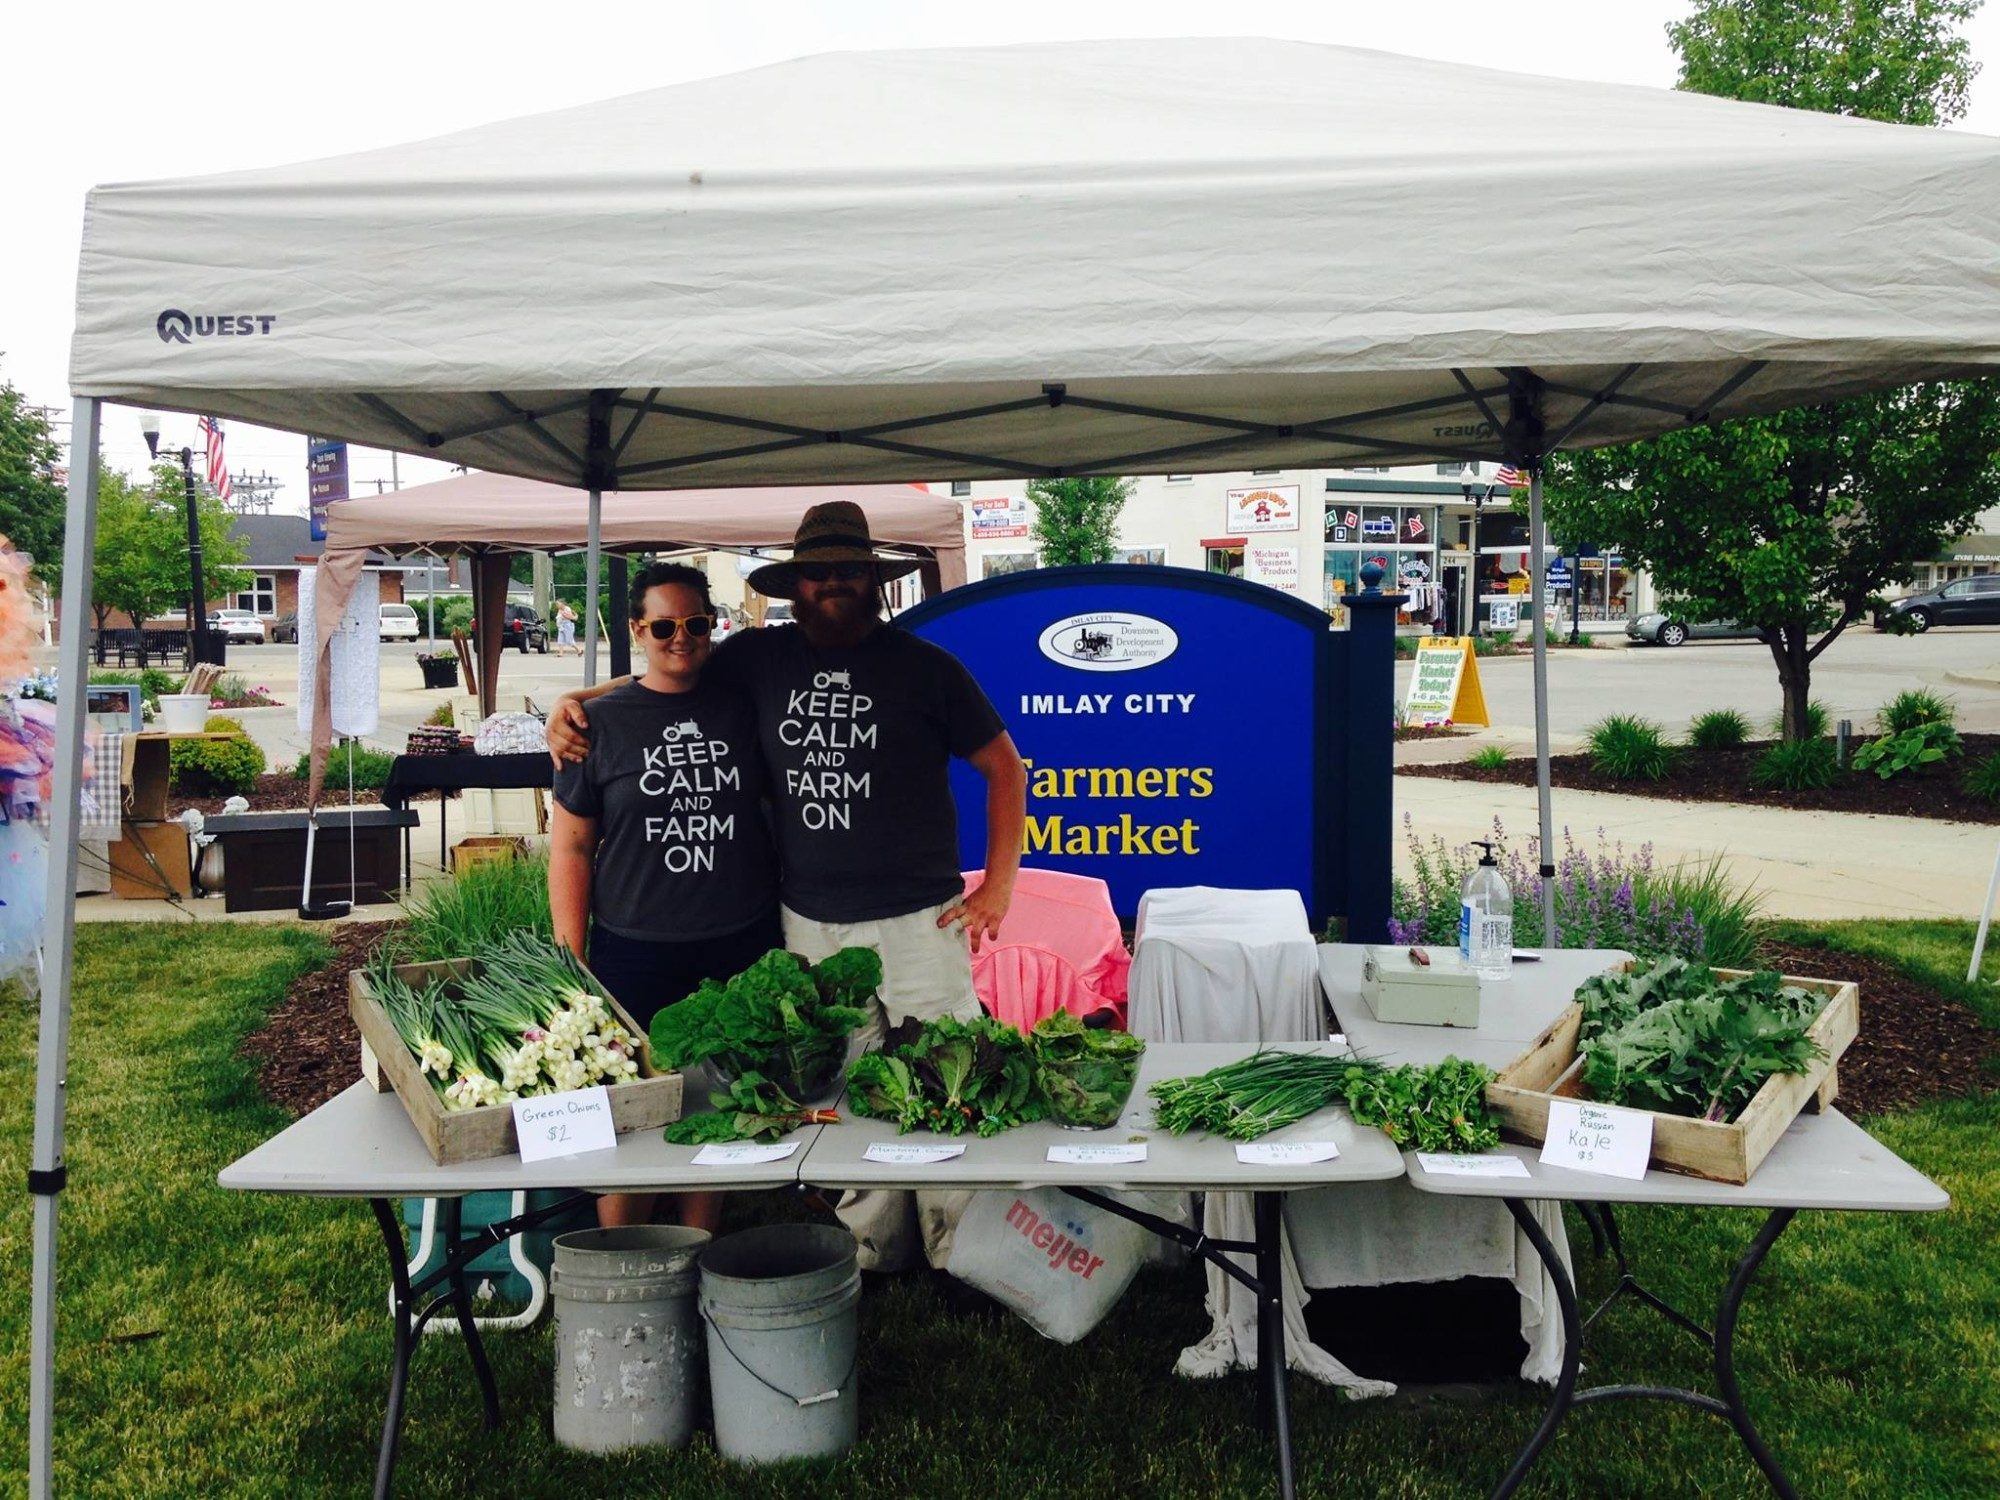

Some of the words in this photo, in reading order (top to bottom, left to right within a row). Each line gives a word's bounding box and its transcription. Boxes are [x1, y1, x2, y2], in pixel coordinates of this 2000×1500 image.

[157, 309, 276, 344] QUEST
[1252, 549, 1289, 559] Michigan
[1255, 559, 1292, 567] Business
[1261, 567, 1297, 575] Products
[1546, 572, 1571, 580] Business
[1546, 581, 1571, 589] Products
[1071, 616, 1094, 625] IMLAY
[1095, 614, 1113, 622] CITY
[1121, 626, 1159, 635] Downtown
[1116, 638, 1164, 647] Development
[1122, 648, 1157, 658] Authority
[1419, 665, 1456, 678] Market
[787, 689, 873, 719] KEEP
[1021, 695, 1113, 714] IMLAY
[1124, 694, 1196, 714] CITY
[778, 719, 877, 749] CALM
[643, 740, 729, 770] KEEP
[803, 750, 846, 767] AND
[639, 766, 740, 796] CALM
[786, 769, 870, 798] FARM
[669, 796, 712, 812] AND
[802, 802, 850, 830] ON
[645, 814, 734, 842] FARM
[1021, 813, 1201, 855] Market
[664, 845, 714, 873] ON
[522, 1108, 565, 1123] Green
[567, 1101, 602, 1114] Onions
[1579, 1106, 1608, 1119] Organic
[1580, 1117, 1615, 1130] Russian
[547, 1124, 572, 1142] $2
[1568, 1129, 1611, 1150] Kale
[1005, 1199, 1106, 1280] meijer
